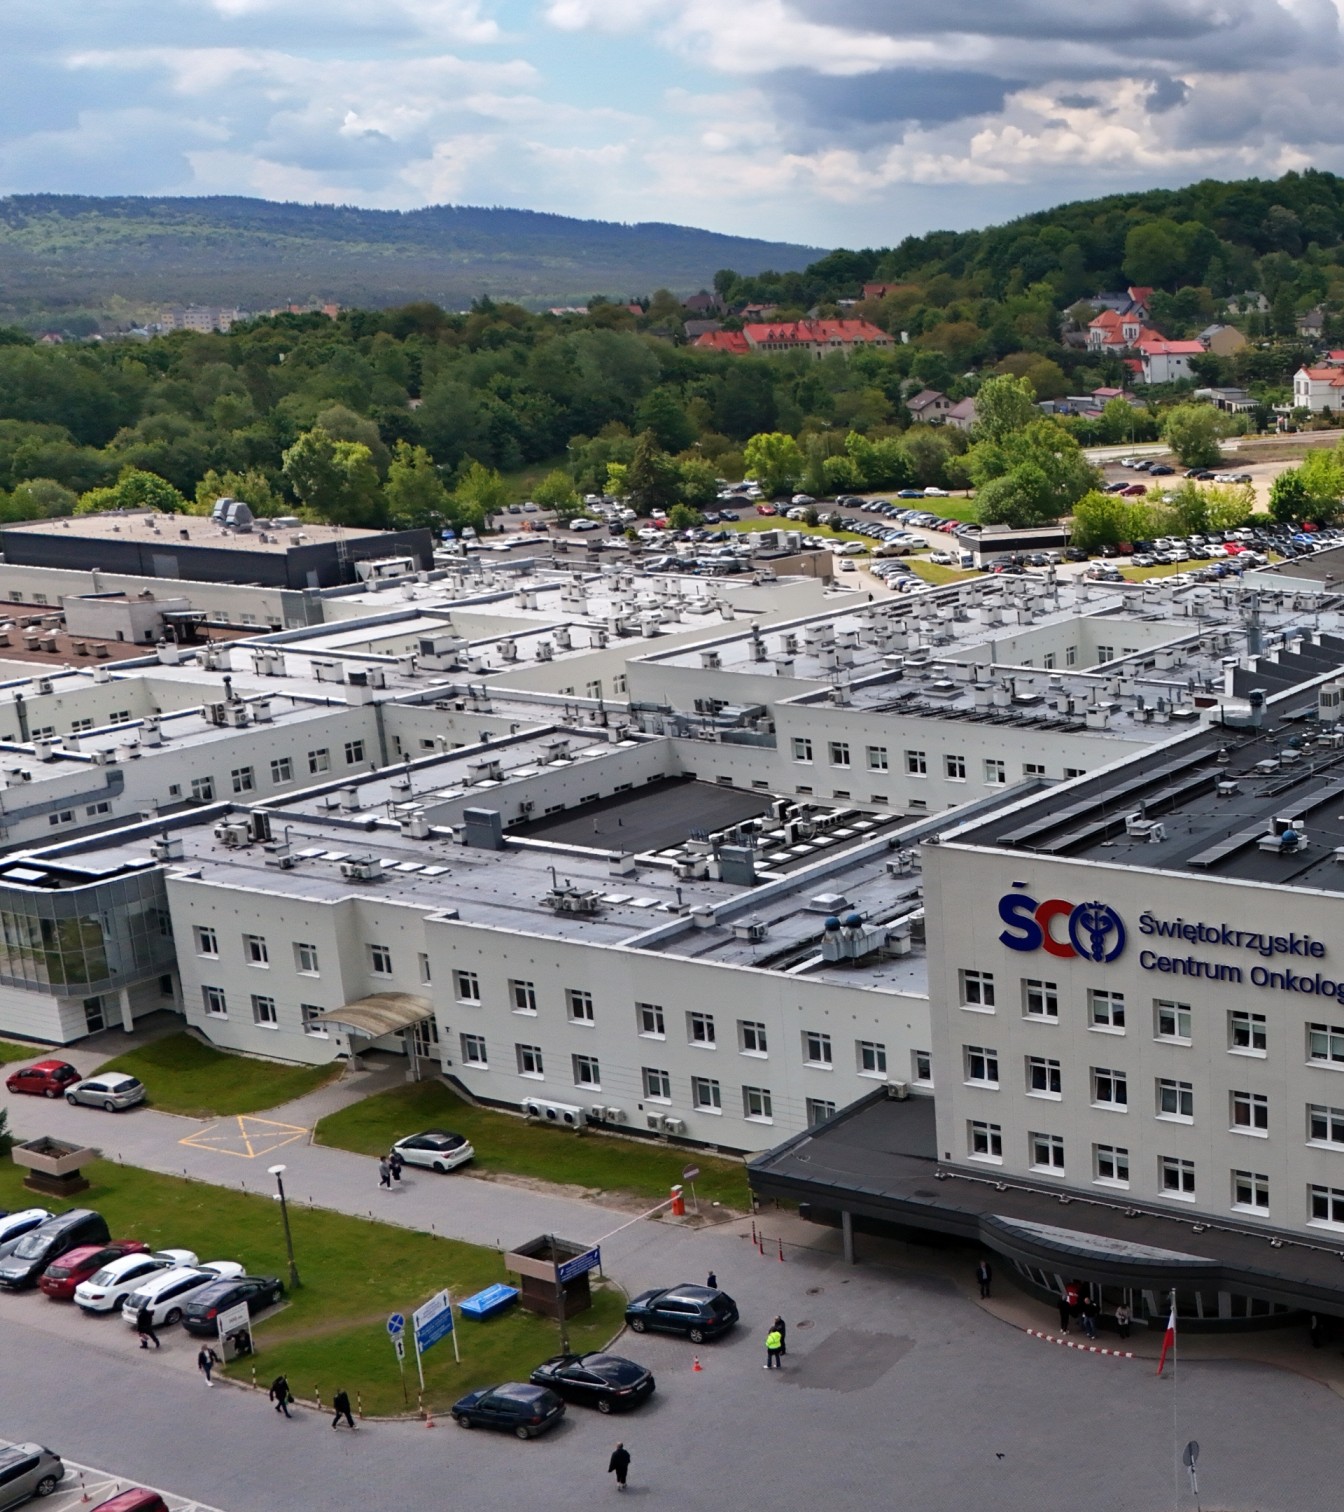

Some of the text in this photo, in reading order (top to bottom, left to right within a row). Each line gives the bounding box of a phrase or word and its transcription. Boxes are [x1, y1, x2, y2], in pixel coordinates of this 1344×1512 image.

[998, 881, 1126, 964] ŚCO
[1138, 910, 1327, 958] Świętokrzyskie
[1139, 950, 1243, 984] Centrum
